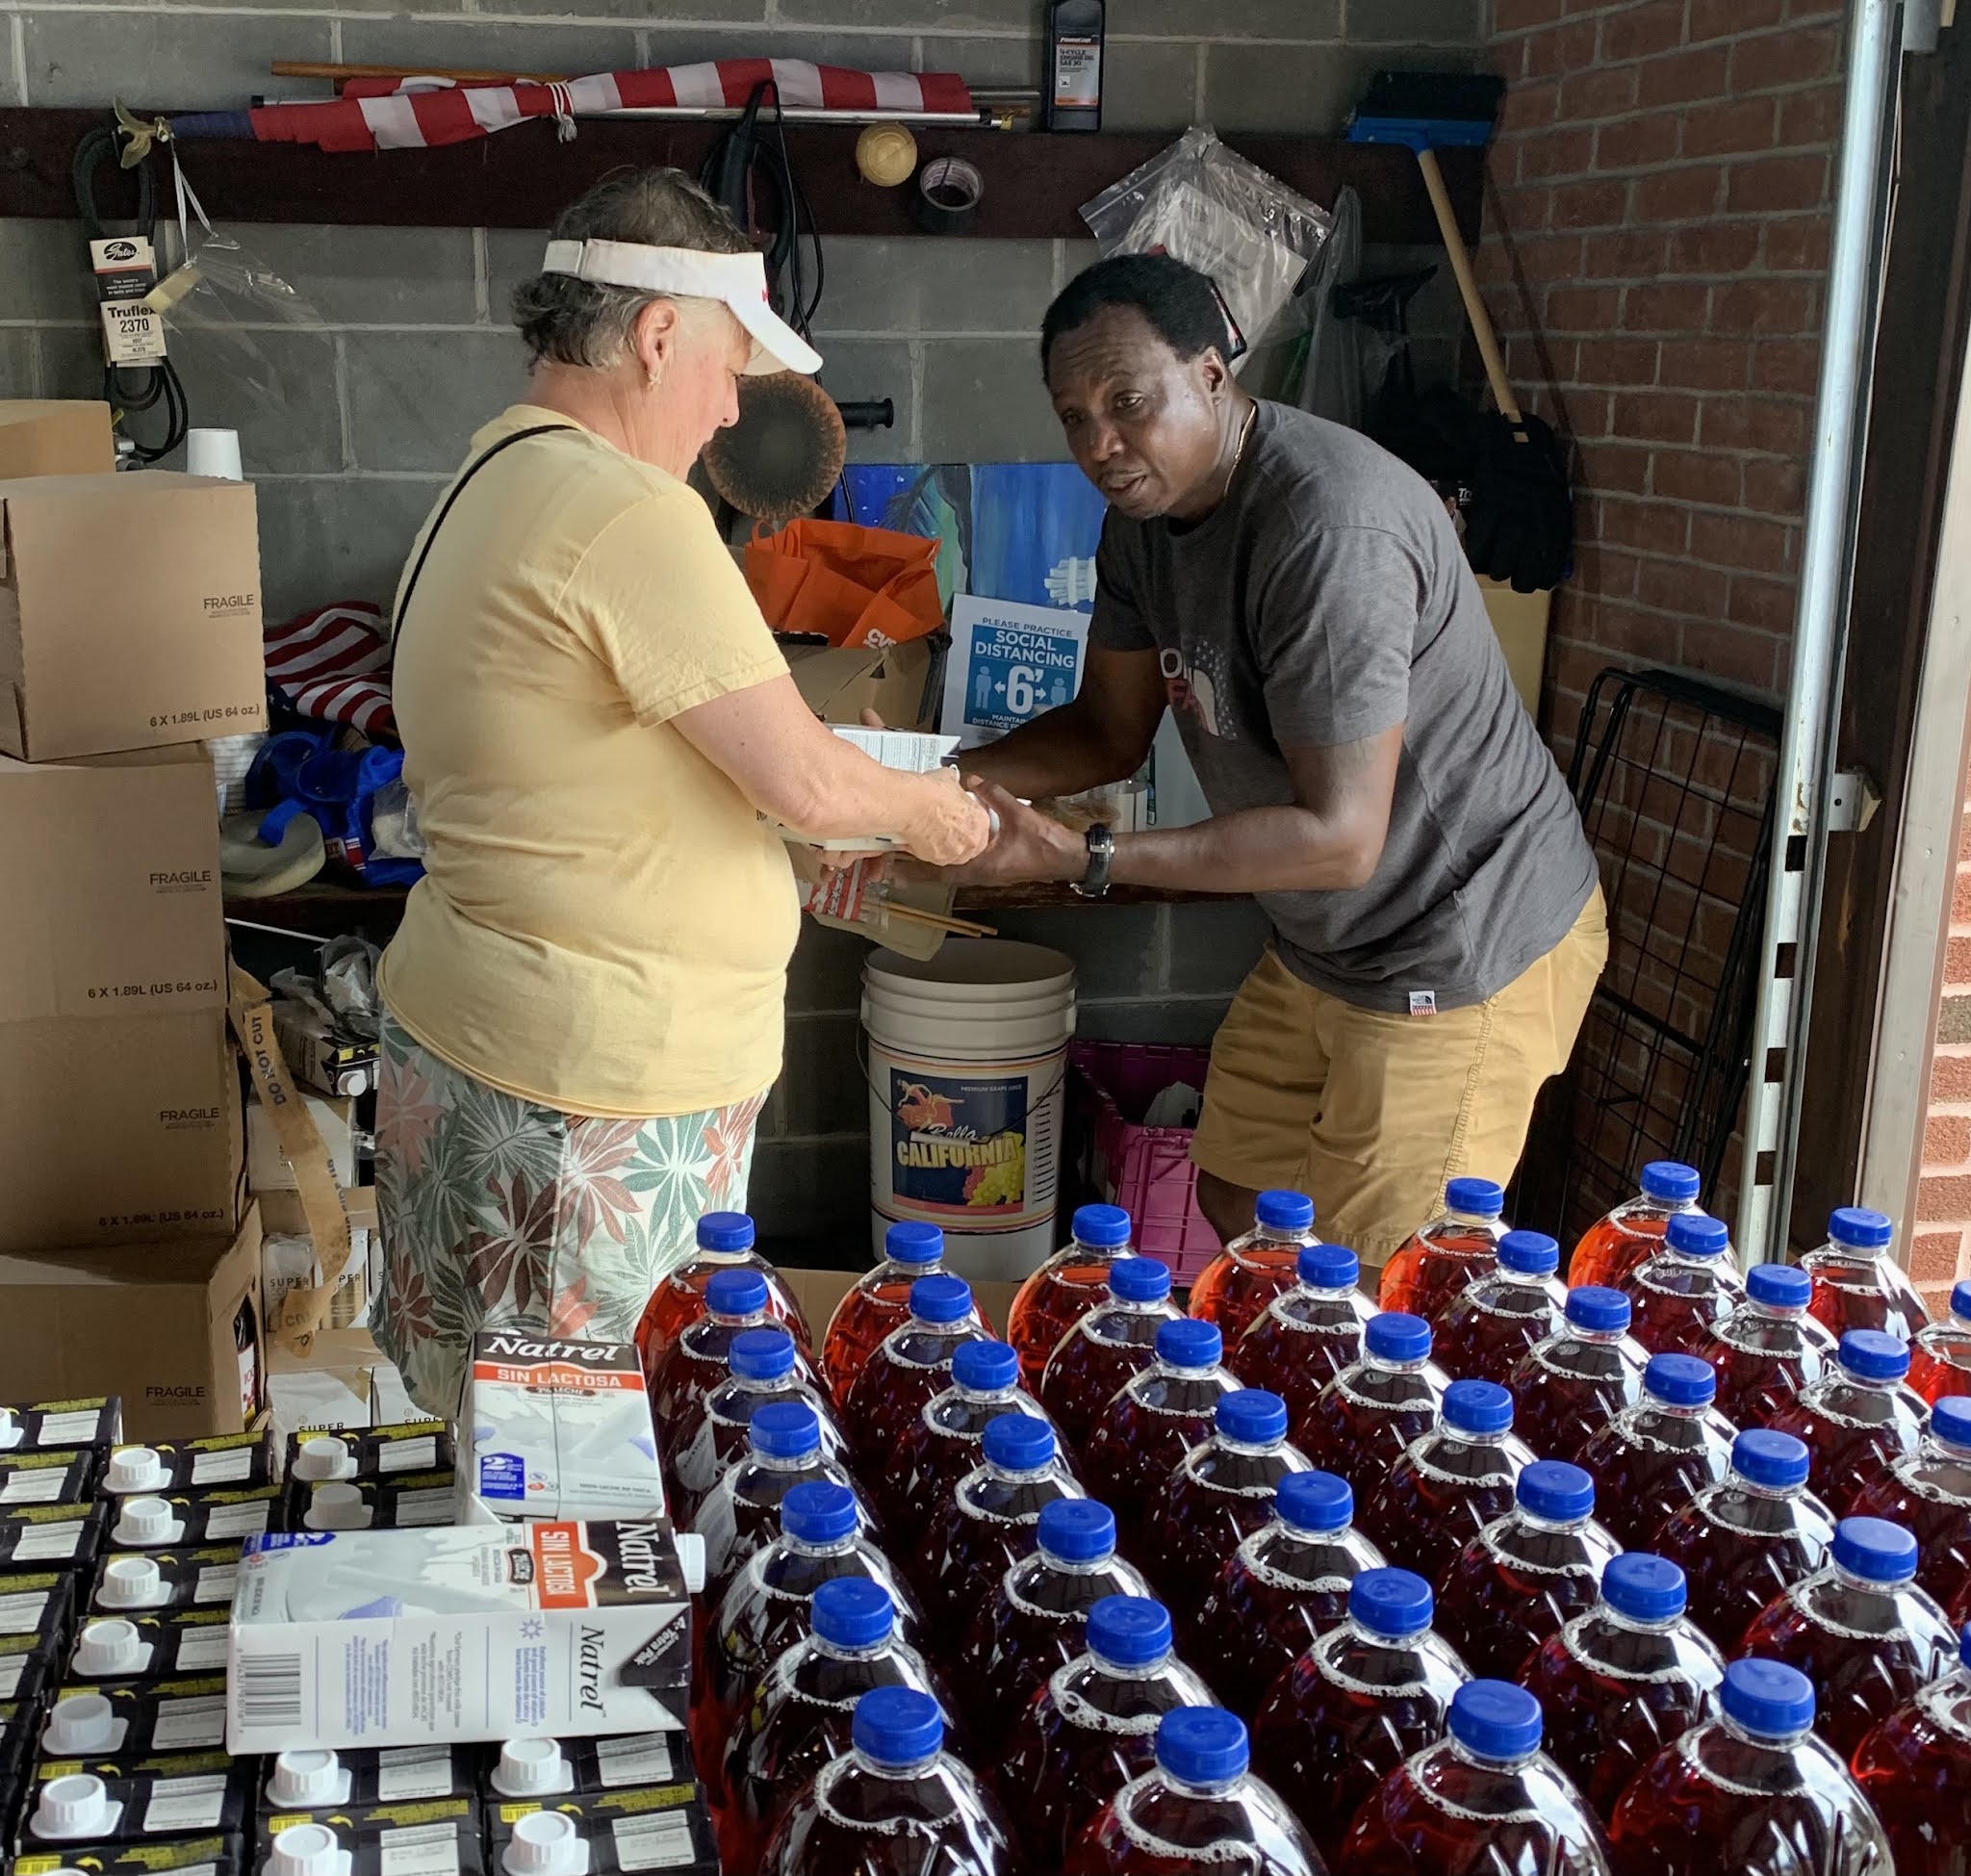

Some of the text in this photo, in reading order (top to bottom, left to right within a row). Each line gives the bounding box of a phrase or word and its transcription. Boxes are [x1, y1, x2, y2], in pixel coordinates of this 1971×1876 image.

[108, 305, 156, 319] Truflex
[119, 319, 150, 333] 2370
[204, 594, 254, 609] FRAGILE
[982, 617, 1072, 637] PLEASE PRACTICE
[995, 630, 1057, 652] SOCIAL
[975, 641, 1075, 669] DISTANCING
[150, 716, 158, 728] 6
[160, 716, 168, 725] X
[171, 712, 200, 724] 1.89L
[203, 708, 222, 722] (US
[225, 707, 238, 716] 64
[972, 717, 1010, 730] DISTANCE
[149, 870, 212, 886] FRAGILE
[89, 989, 95, 998] 6
[100, 988, 109, 997] X
[113, 986, 146, 996] 1.89L
[150, 983, 172, 996] (US
[176, 982, 192, 992] 64
[252, 1016, 287, 1106] DO NOT CUT
[160, 1107, 219, 1121] FRAGILE
[927, 1122, 979, 1142] Bella
[896, 1136, 1018, 1169] CALIFORNIA
[270, 1276, 310, 1287] SUPER
[483, 1336, 619, 1361] Natrel
[497, 1369, 622, 1387] SIN LACTOSA
[146, 1386, 205, 1398] FRAGILE
[541, 1531, 576, 1596] SIN LACTOSA
[616, 1521, 670, 1594] Natrel
[634, 1646, 654, 1666] Pak
[580, 1625, 605, 1711] Natrel
